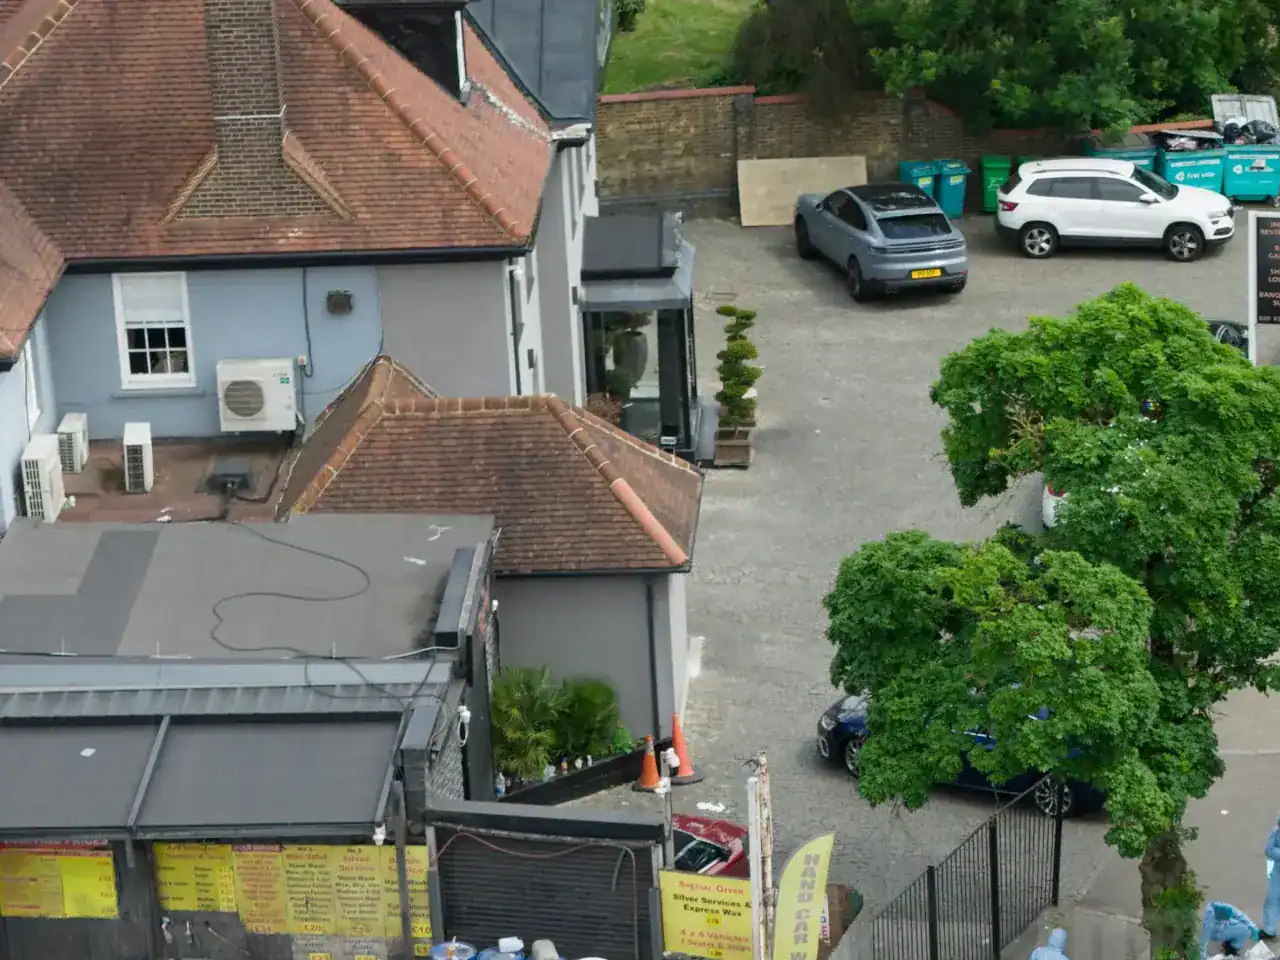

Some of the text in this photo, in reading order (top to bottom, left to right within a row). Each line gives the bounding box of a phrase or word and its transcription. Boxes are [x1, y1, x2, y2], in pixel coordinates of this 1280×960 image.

[797, 854, 820, 904] HAND
[672, 893, 698, 904] Silver
[700, 896, 742, 908] Services
[683, 904, 743, 917] Express Wax
[794, 908, 811, 945] CAR
